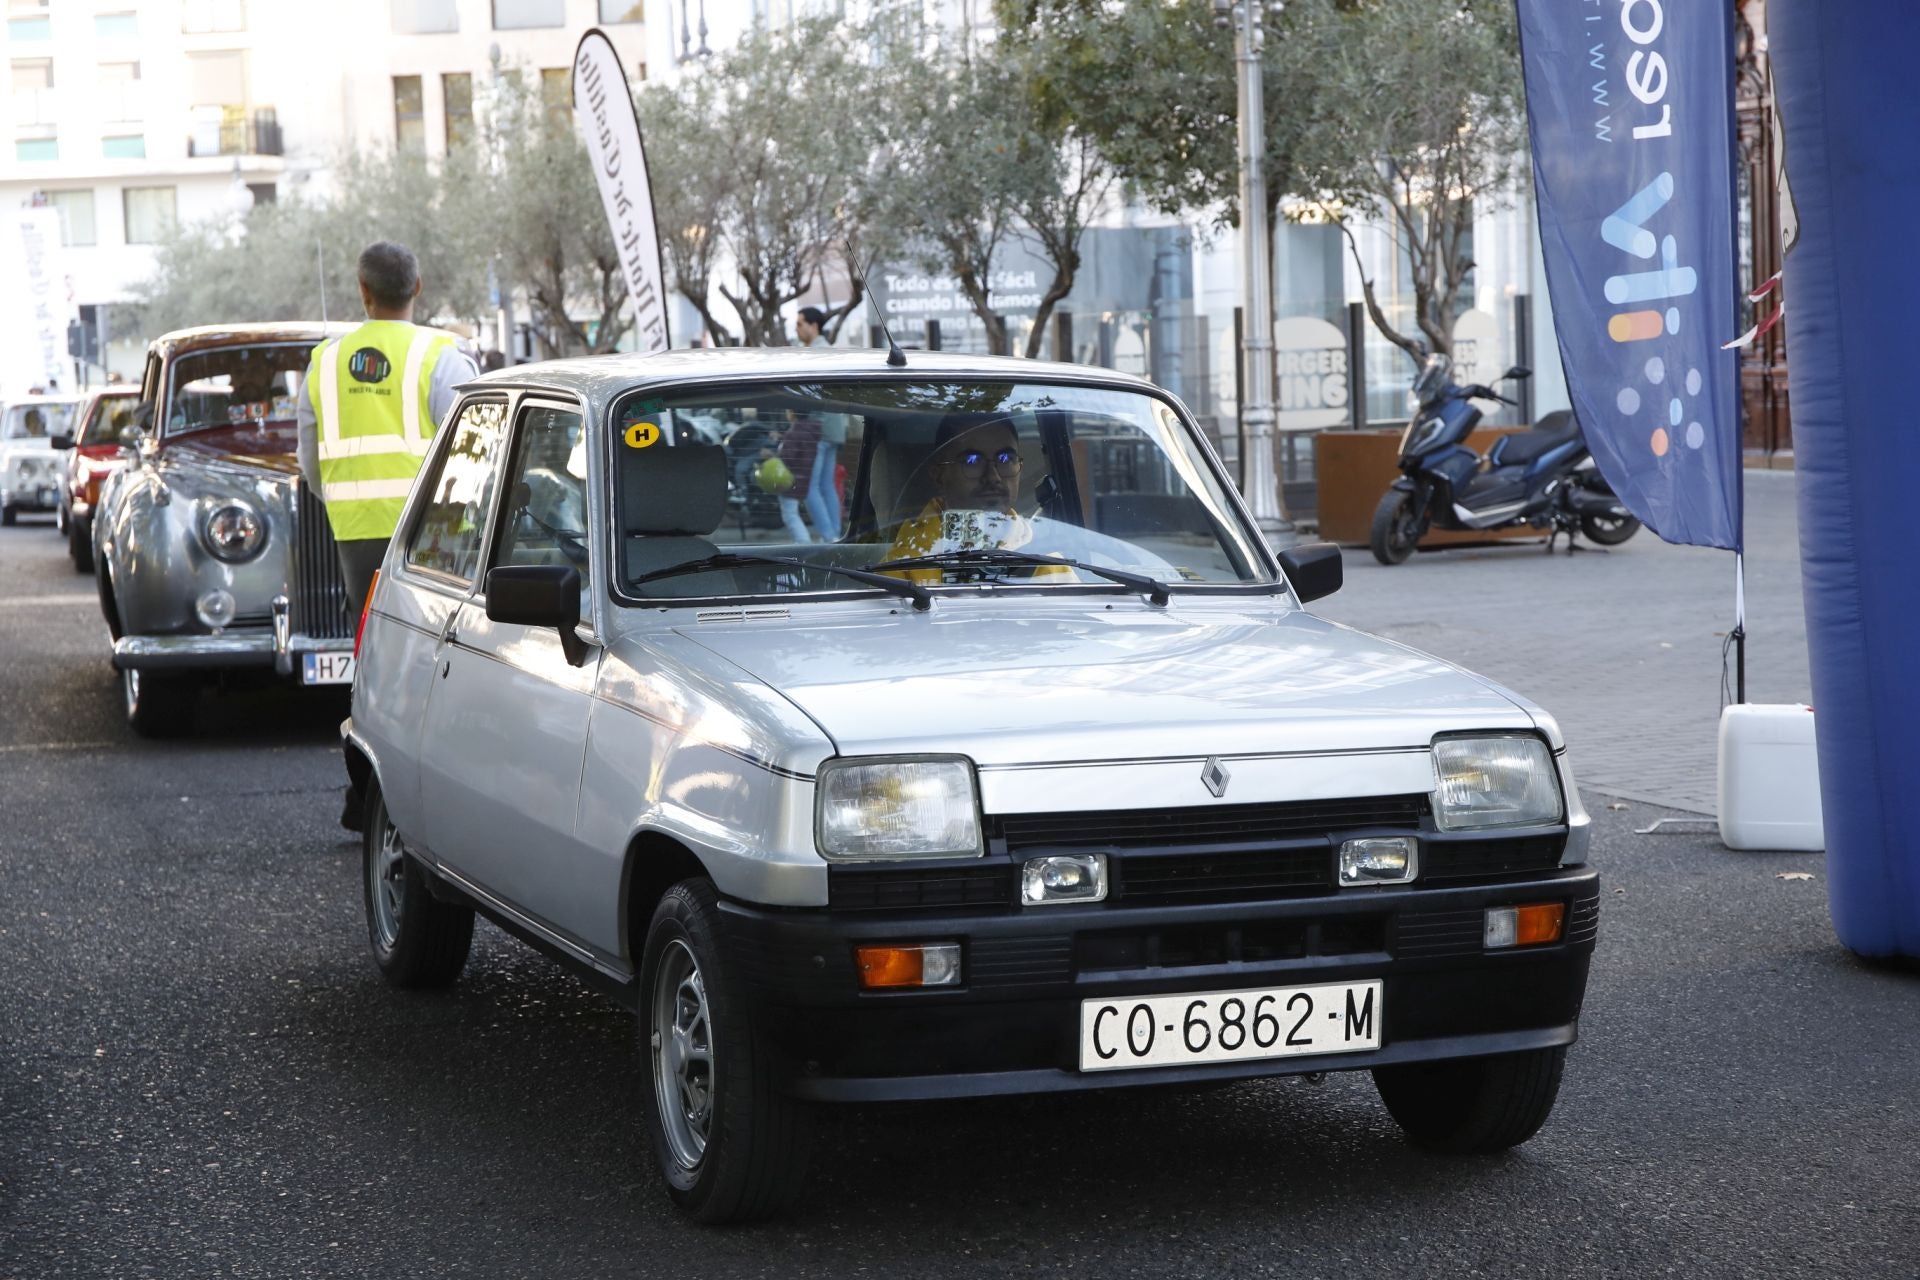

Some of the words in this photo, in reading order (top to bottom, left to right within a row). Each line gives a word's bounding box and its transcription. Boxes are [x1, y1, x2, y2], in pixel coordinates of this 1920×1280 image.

[885, 275, 930, 292] Todo
[886, 294, 953, 313] cuando
[954, 292, 1042, 311] hlamos
[886, 315, 905, 332] el
[908, 314, 967, 331] mimo
[1276, 349, 1348, 376] RGER
[1278, 373, 1348, 410] ING
[635, 428, 650, 442] H
